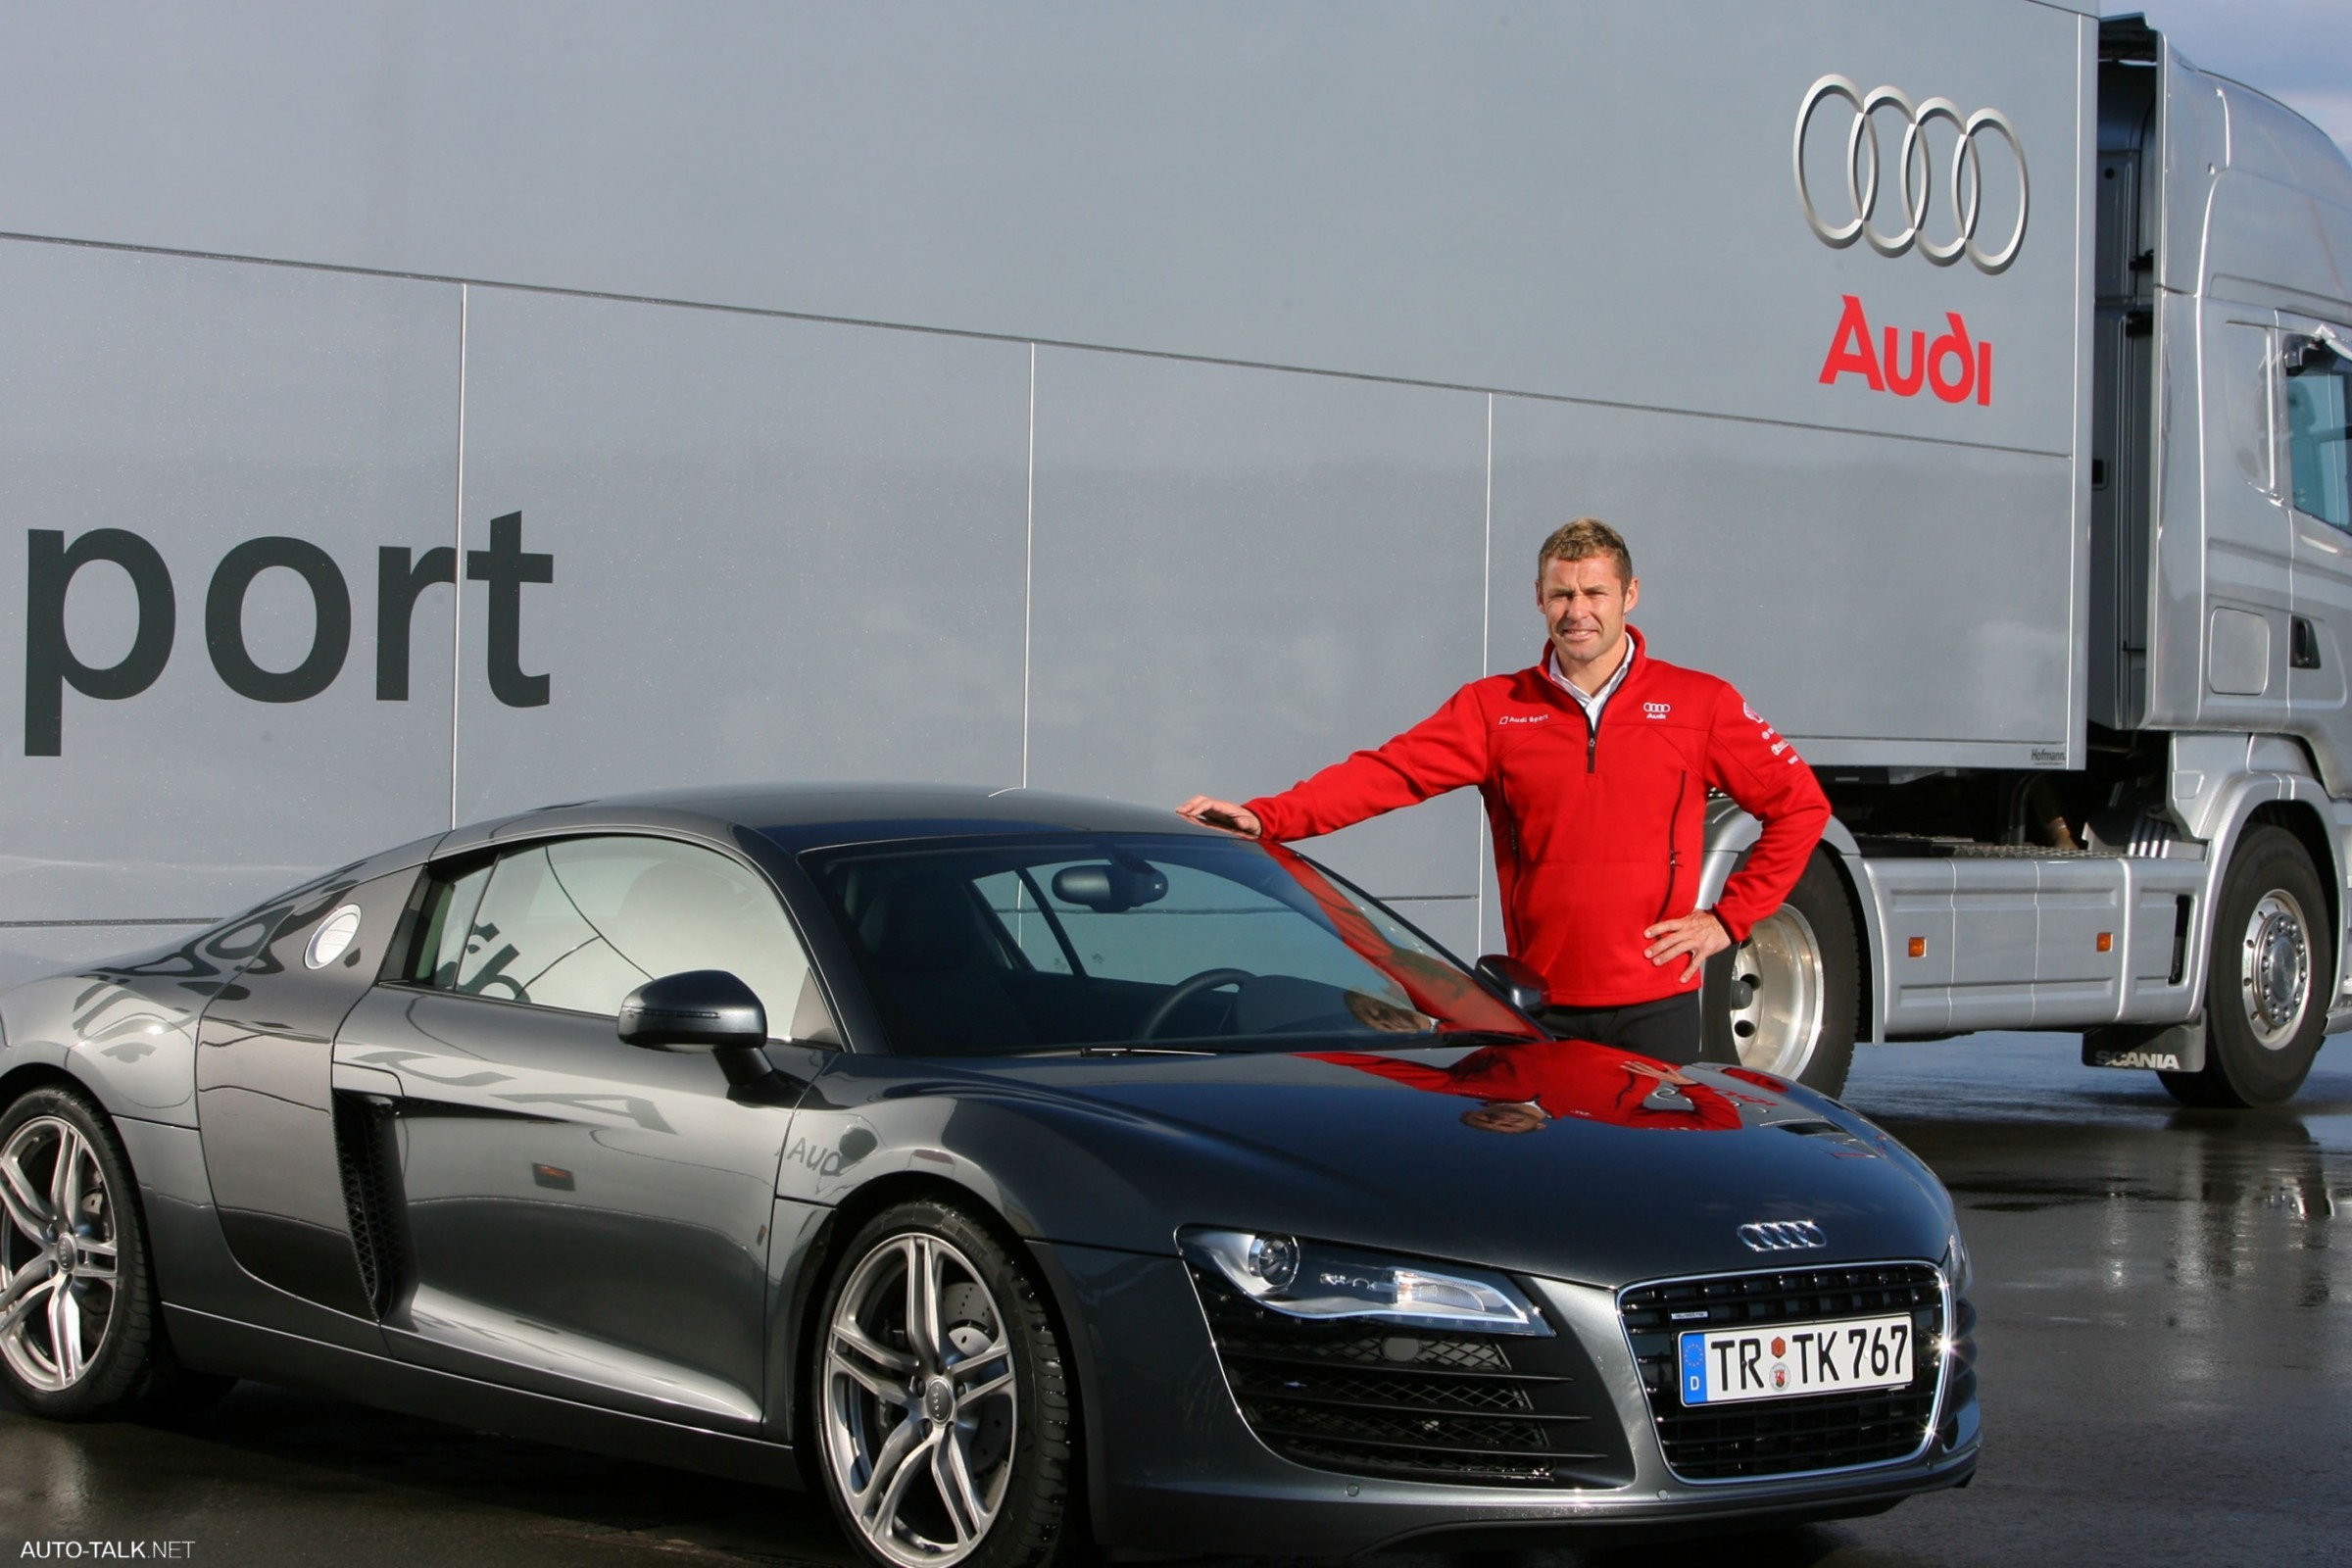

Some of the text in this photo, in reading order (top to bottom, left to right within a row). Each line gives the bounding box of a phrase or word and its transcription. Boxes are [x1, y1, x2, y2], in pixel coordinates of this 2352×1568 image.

[1819, 294, 1991, 407] Audi
[24, 510, 554, 757] port
[1529, 714, 1548, 723] Sport
[2094, 1051, 2180, 1069] SCANIA
[1711, 1324, 1908, 1391] TR TK 767
[1690, 1376, 1699, 1391] D
